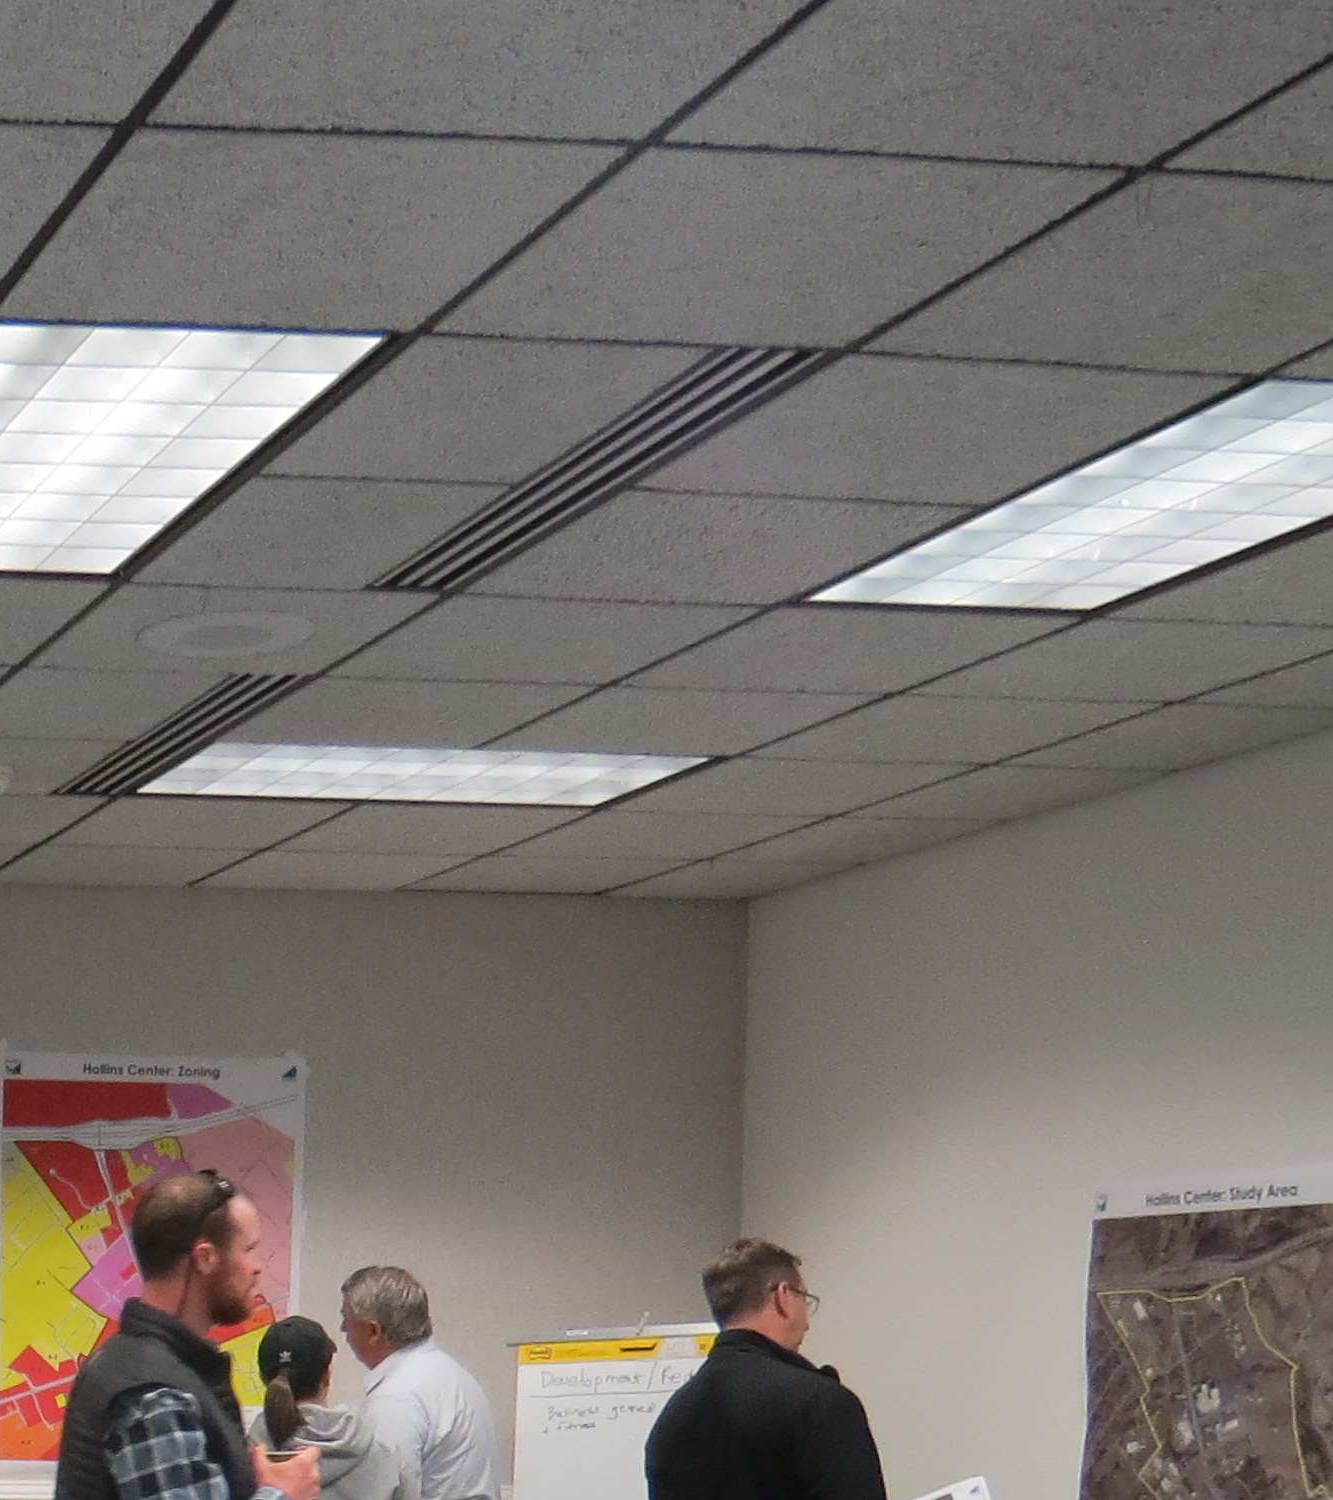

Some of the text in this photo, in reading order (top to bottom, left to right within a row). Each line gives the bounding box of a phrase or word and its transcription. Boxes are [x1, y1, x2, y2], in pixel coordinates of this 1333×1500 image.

[83, 1063, 221, 1080] Hollins Center: Zoning
[1144, 1192, 1181, 1208] Hollins
[1229, 1186, 1262, 1203] Study
[1265, 1184, 1299, 1199] Area
